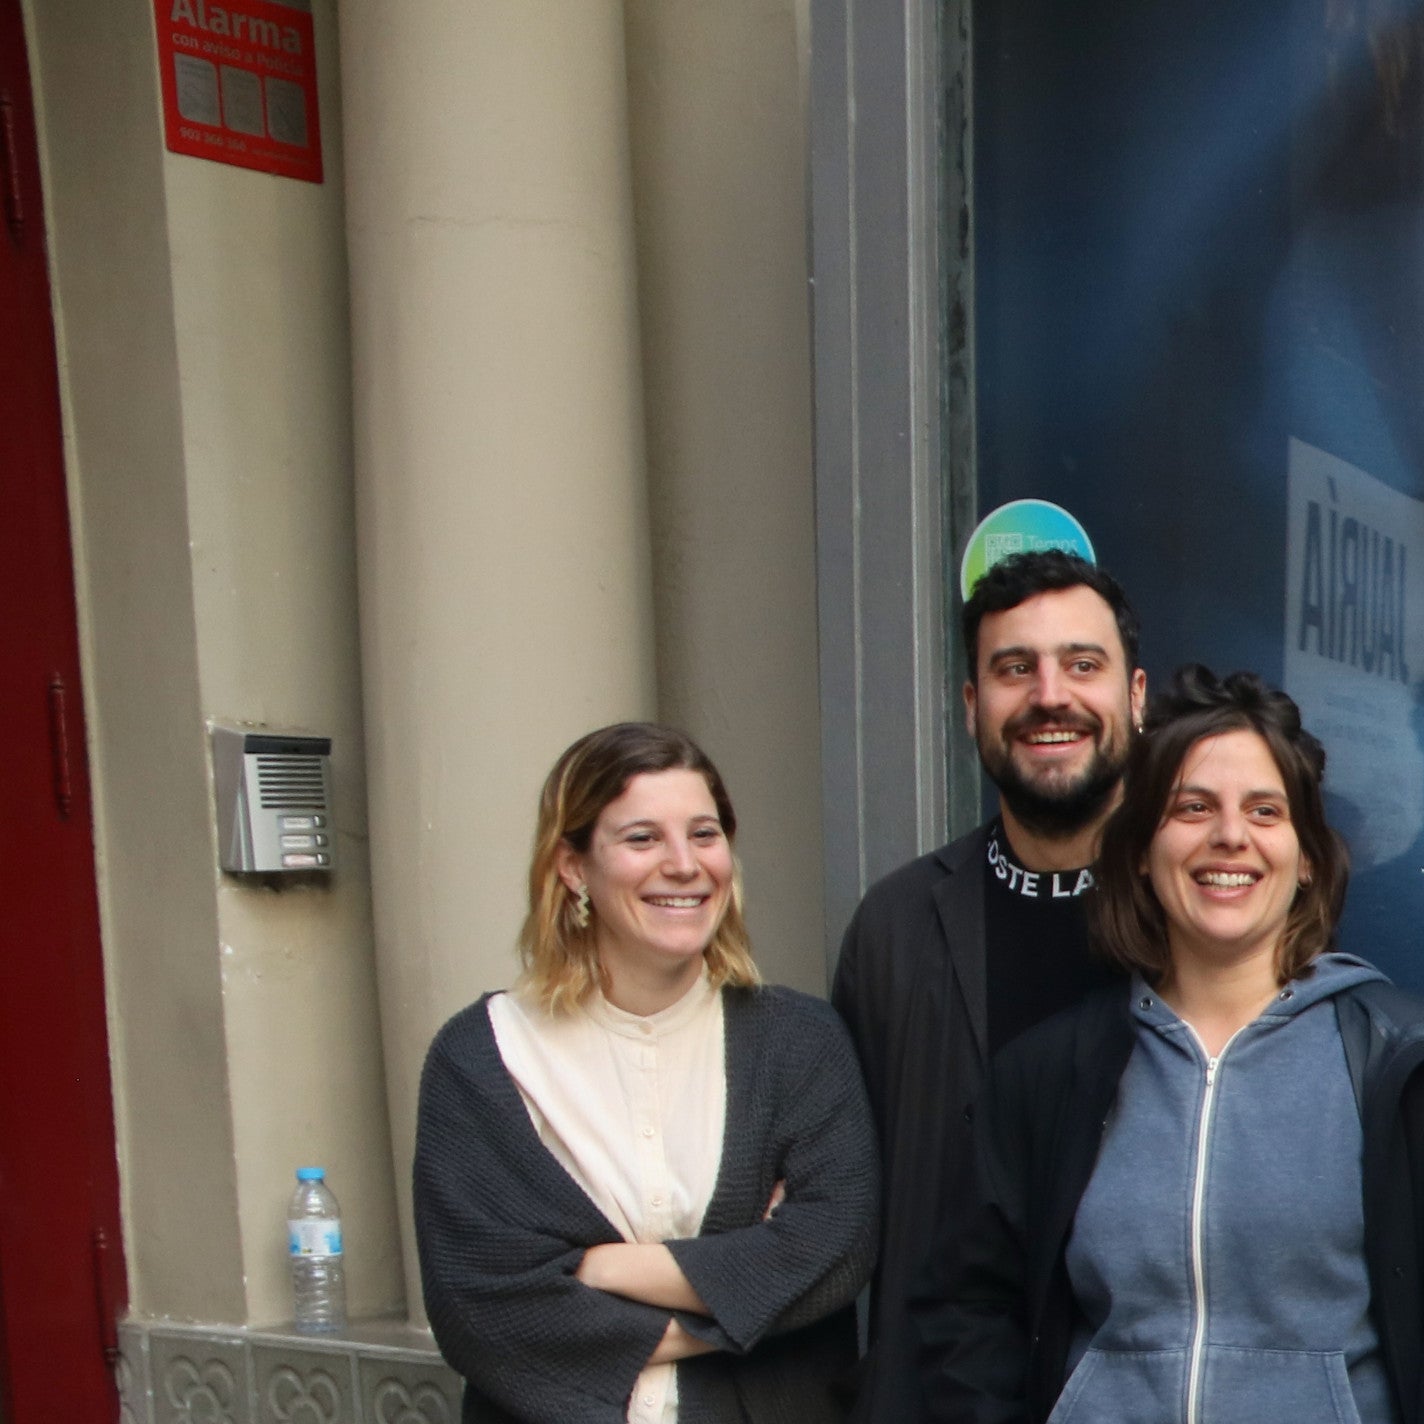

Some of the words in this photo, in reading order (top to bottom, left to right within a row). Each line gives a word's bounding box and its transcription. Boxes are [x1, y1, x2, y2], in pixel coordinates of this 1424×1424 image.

[171, 0, 302, 55] Alarma
[172, 33, 199, 48] con
[203, 41, 241, 60] aviso
[987, 840, 1040, 897] OSTE
